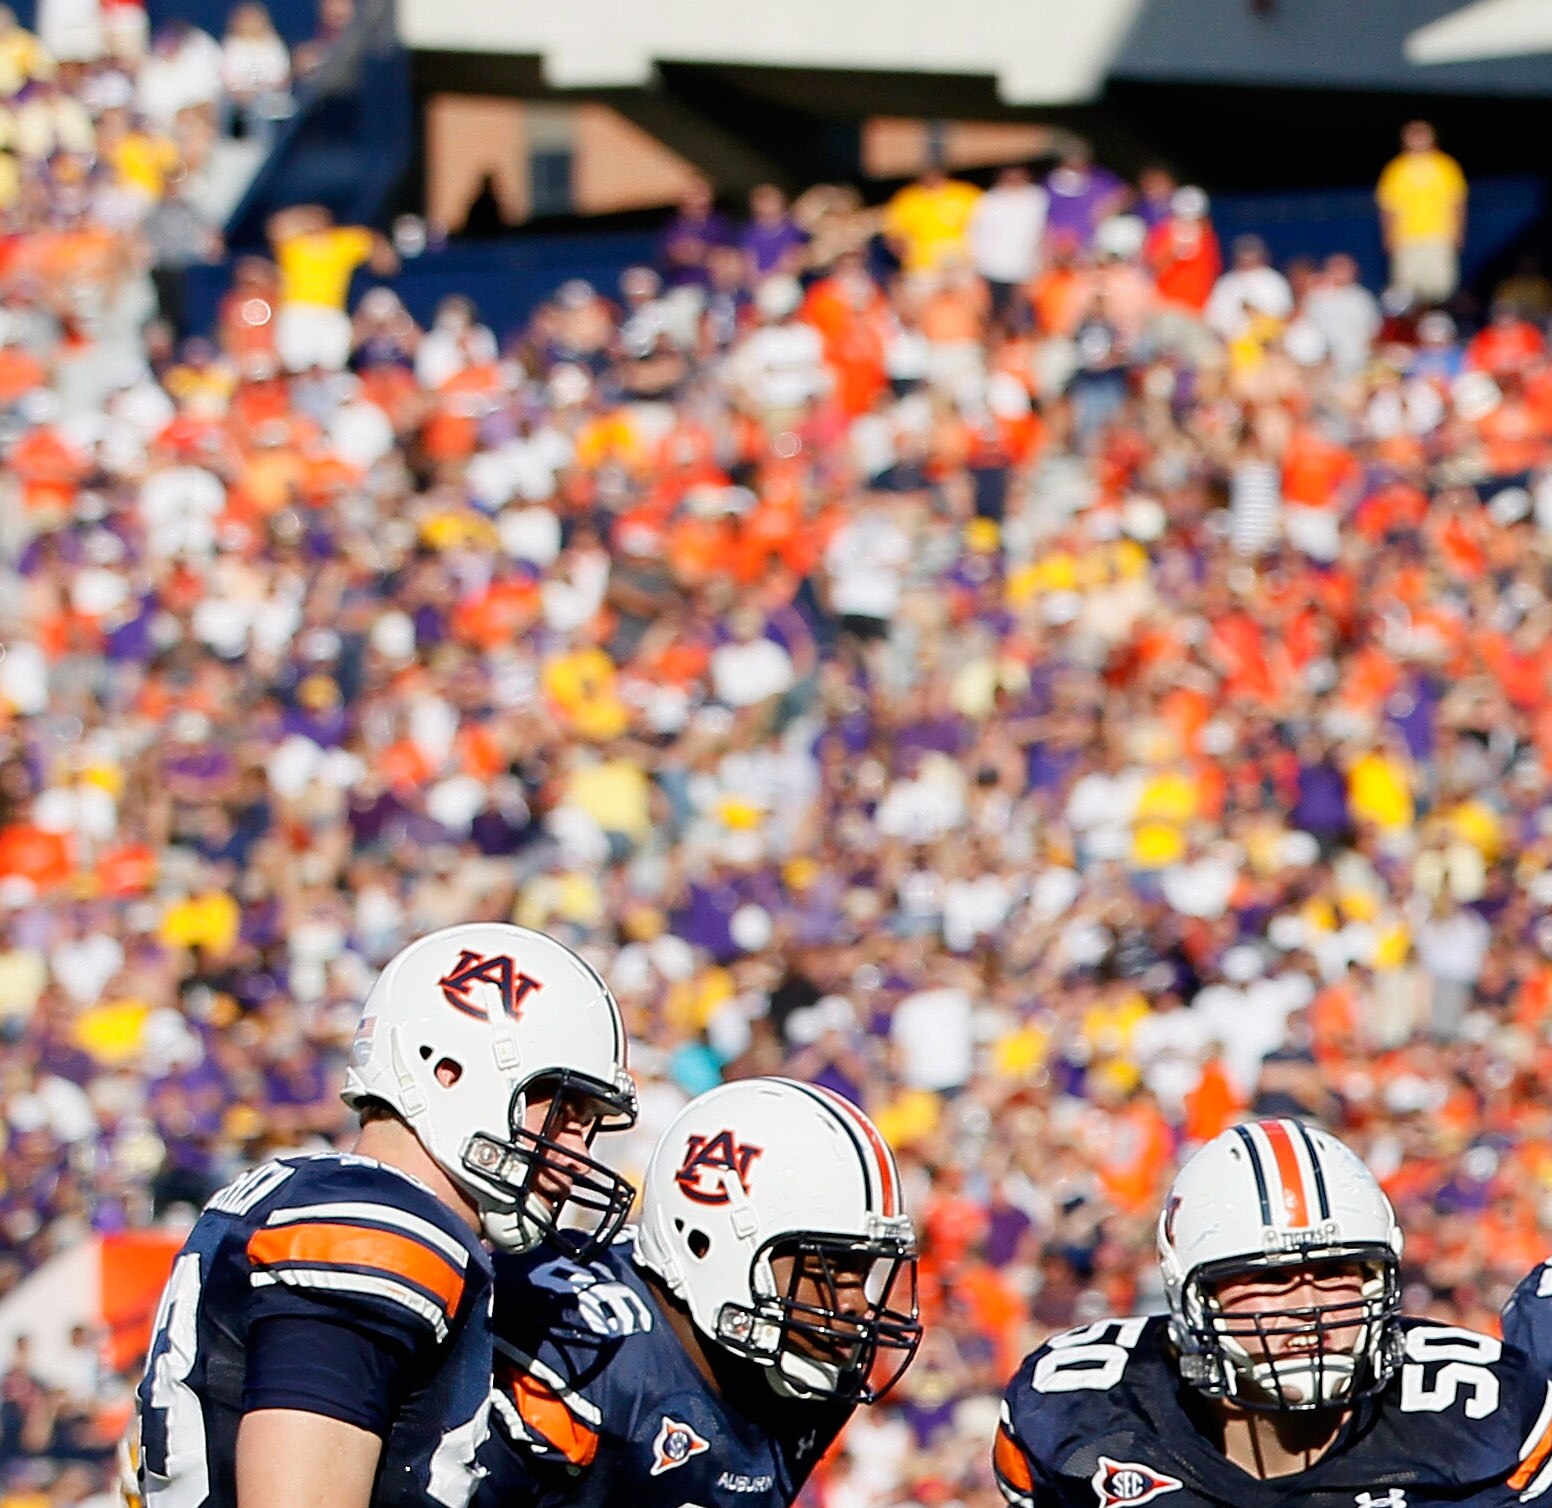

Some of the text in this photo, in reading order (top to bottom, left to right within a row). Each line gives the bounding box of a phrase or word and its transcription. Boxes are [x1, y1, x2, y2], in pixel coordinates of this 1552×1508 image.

[1032, 1316, 1149, 1393] 50
[1400, 1327, 1502, 1419] 50
[717, 1471, 773, 1493] AUBURN
